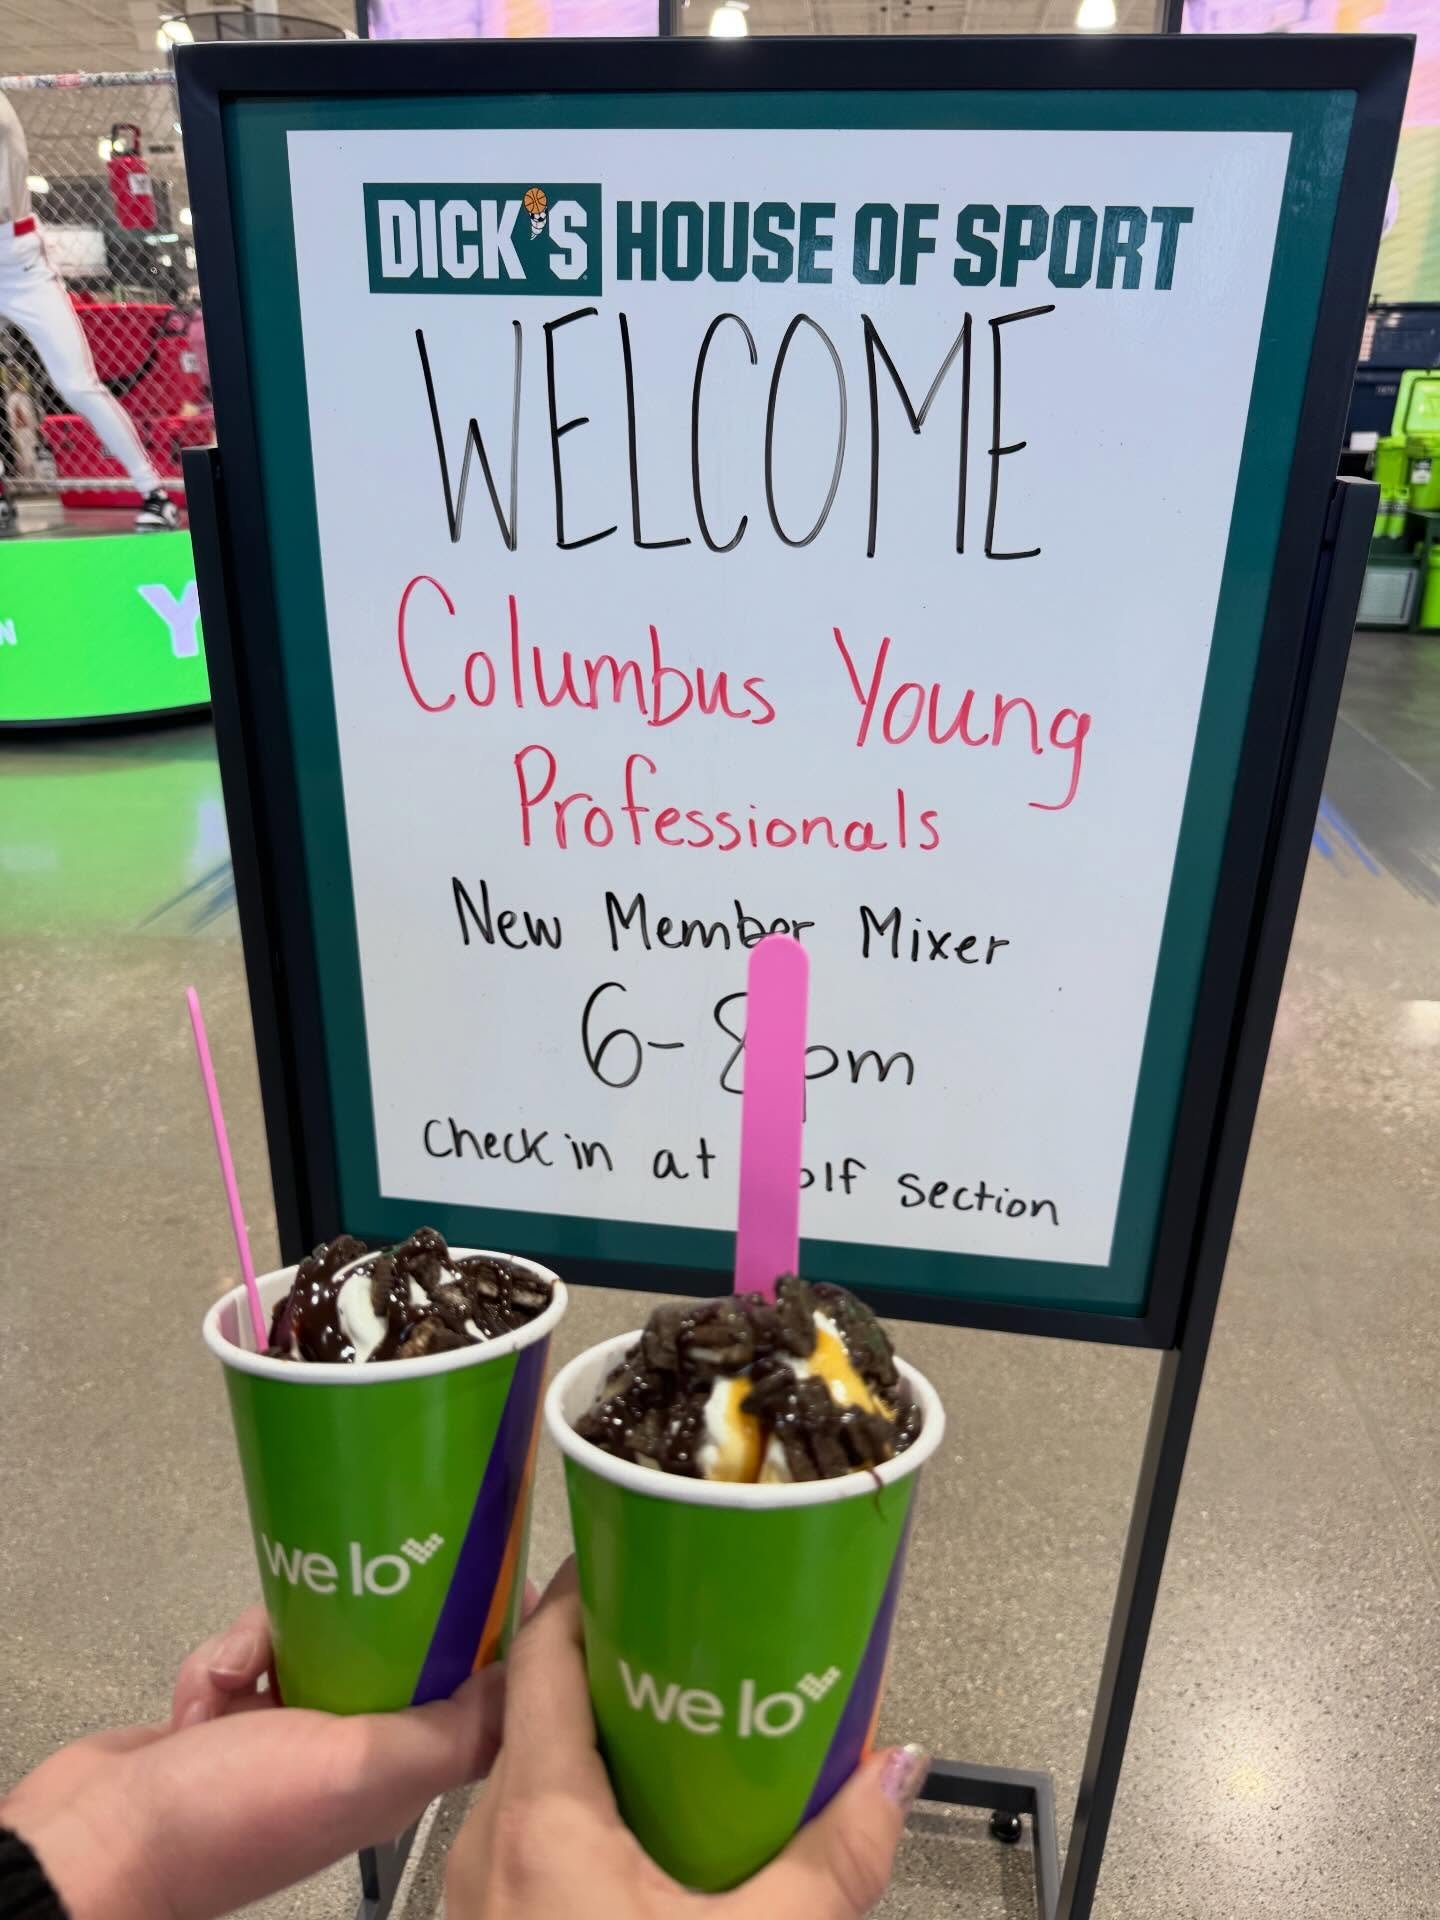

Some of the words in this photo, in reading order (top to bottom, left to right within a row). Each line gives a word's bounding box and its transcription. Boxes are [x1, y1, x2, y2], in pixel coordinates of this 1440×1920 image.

[376, 186, 589, 281] DICK'S
[616, 200, 836, 284] HOUSE
[852, 202, 940, 286] OF
[953, 203, 1194, 291] SPORT
[414, 304, 1056, 561] WELCOME
[397, 575, 776, 727] Columbus
[832, 627, 1091, 810] Young
[513, 744, 948, 853] Professionals
[451, 876, 562, 950] New
[605, 891, 816, 952] Member
[859, 905, 1010, 965] Mixer
[563, 1132, 613, 1172] in
[652, 1137, 716, 1180] at
[800, 1157, 867, 1195] olf
